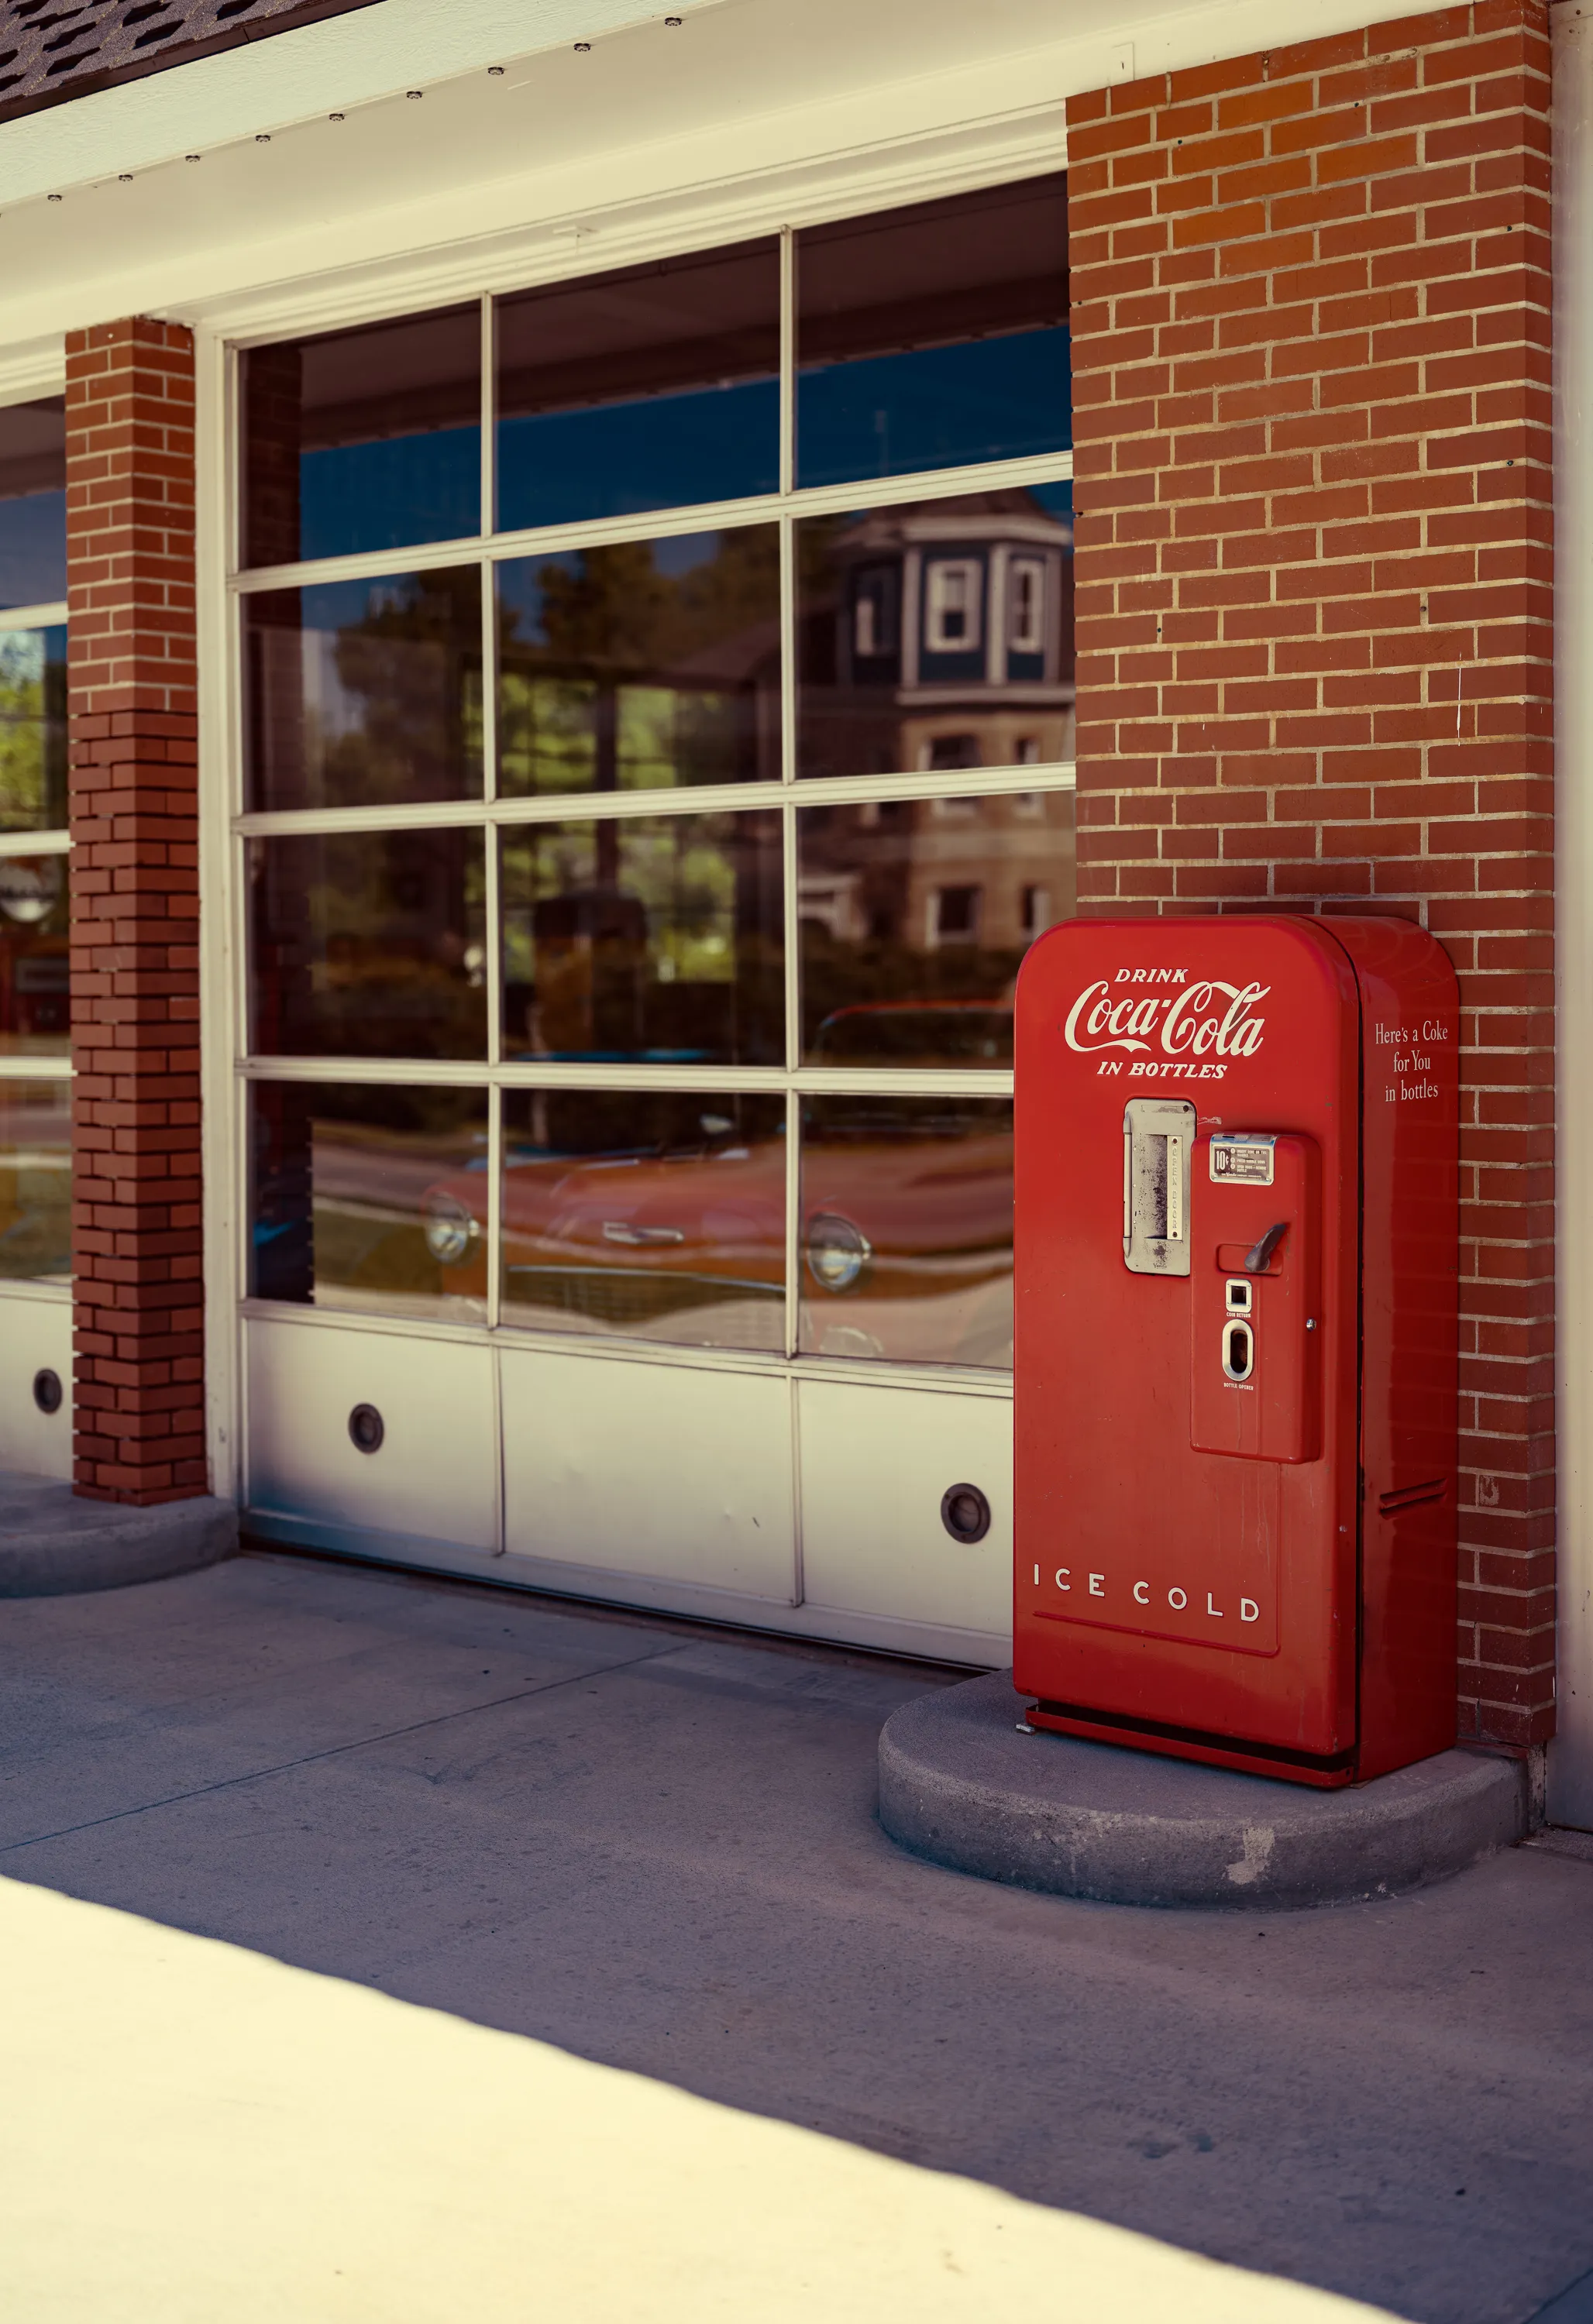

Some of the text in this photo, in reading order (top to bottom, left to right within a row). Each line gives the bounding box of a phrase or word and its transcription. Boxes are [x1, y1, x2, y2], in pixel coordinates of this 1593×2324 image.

[1114, 968, 1189, 983] DRINK
[1065, 980, 1271, 1057] Coca-Cola
[1375, 1019, 1448, 1044] Here's a Coke
[1097, 1061, 1228, 1079] IN BOTTLES
[1393, 1050, 1431, 1072] for You
[1385, 1078, 1439, 1102] in bottles
[1034, 1563, 1260, 1622] ICE COLD
